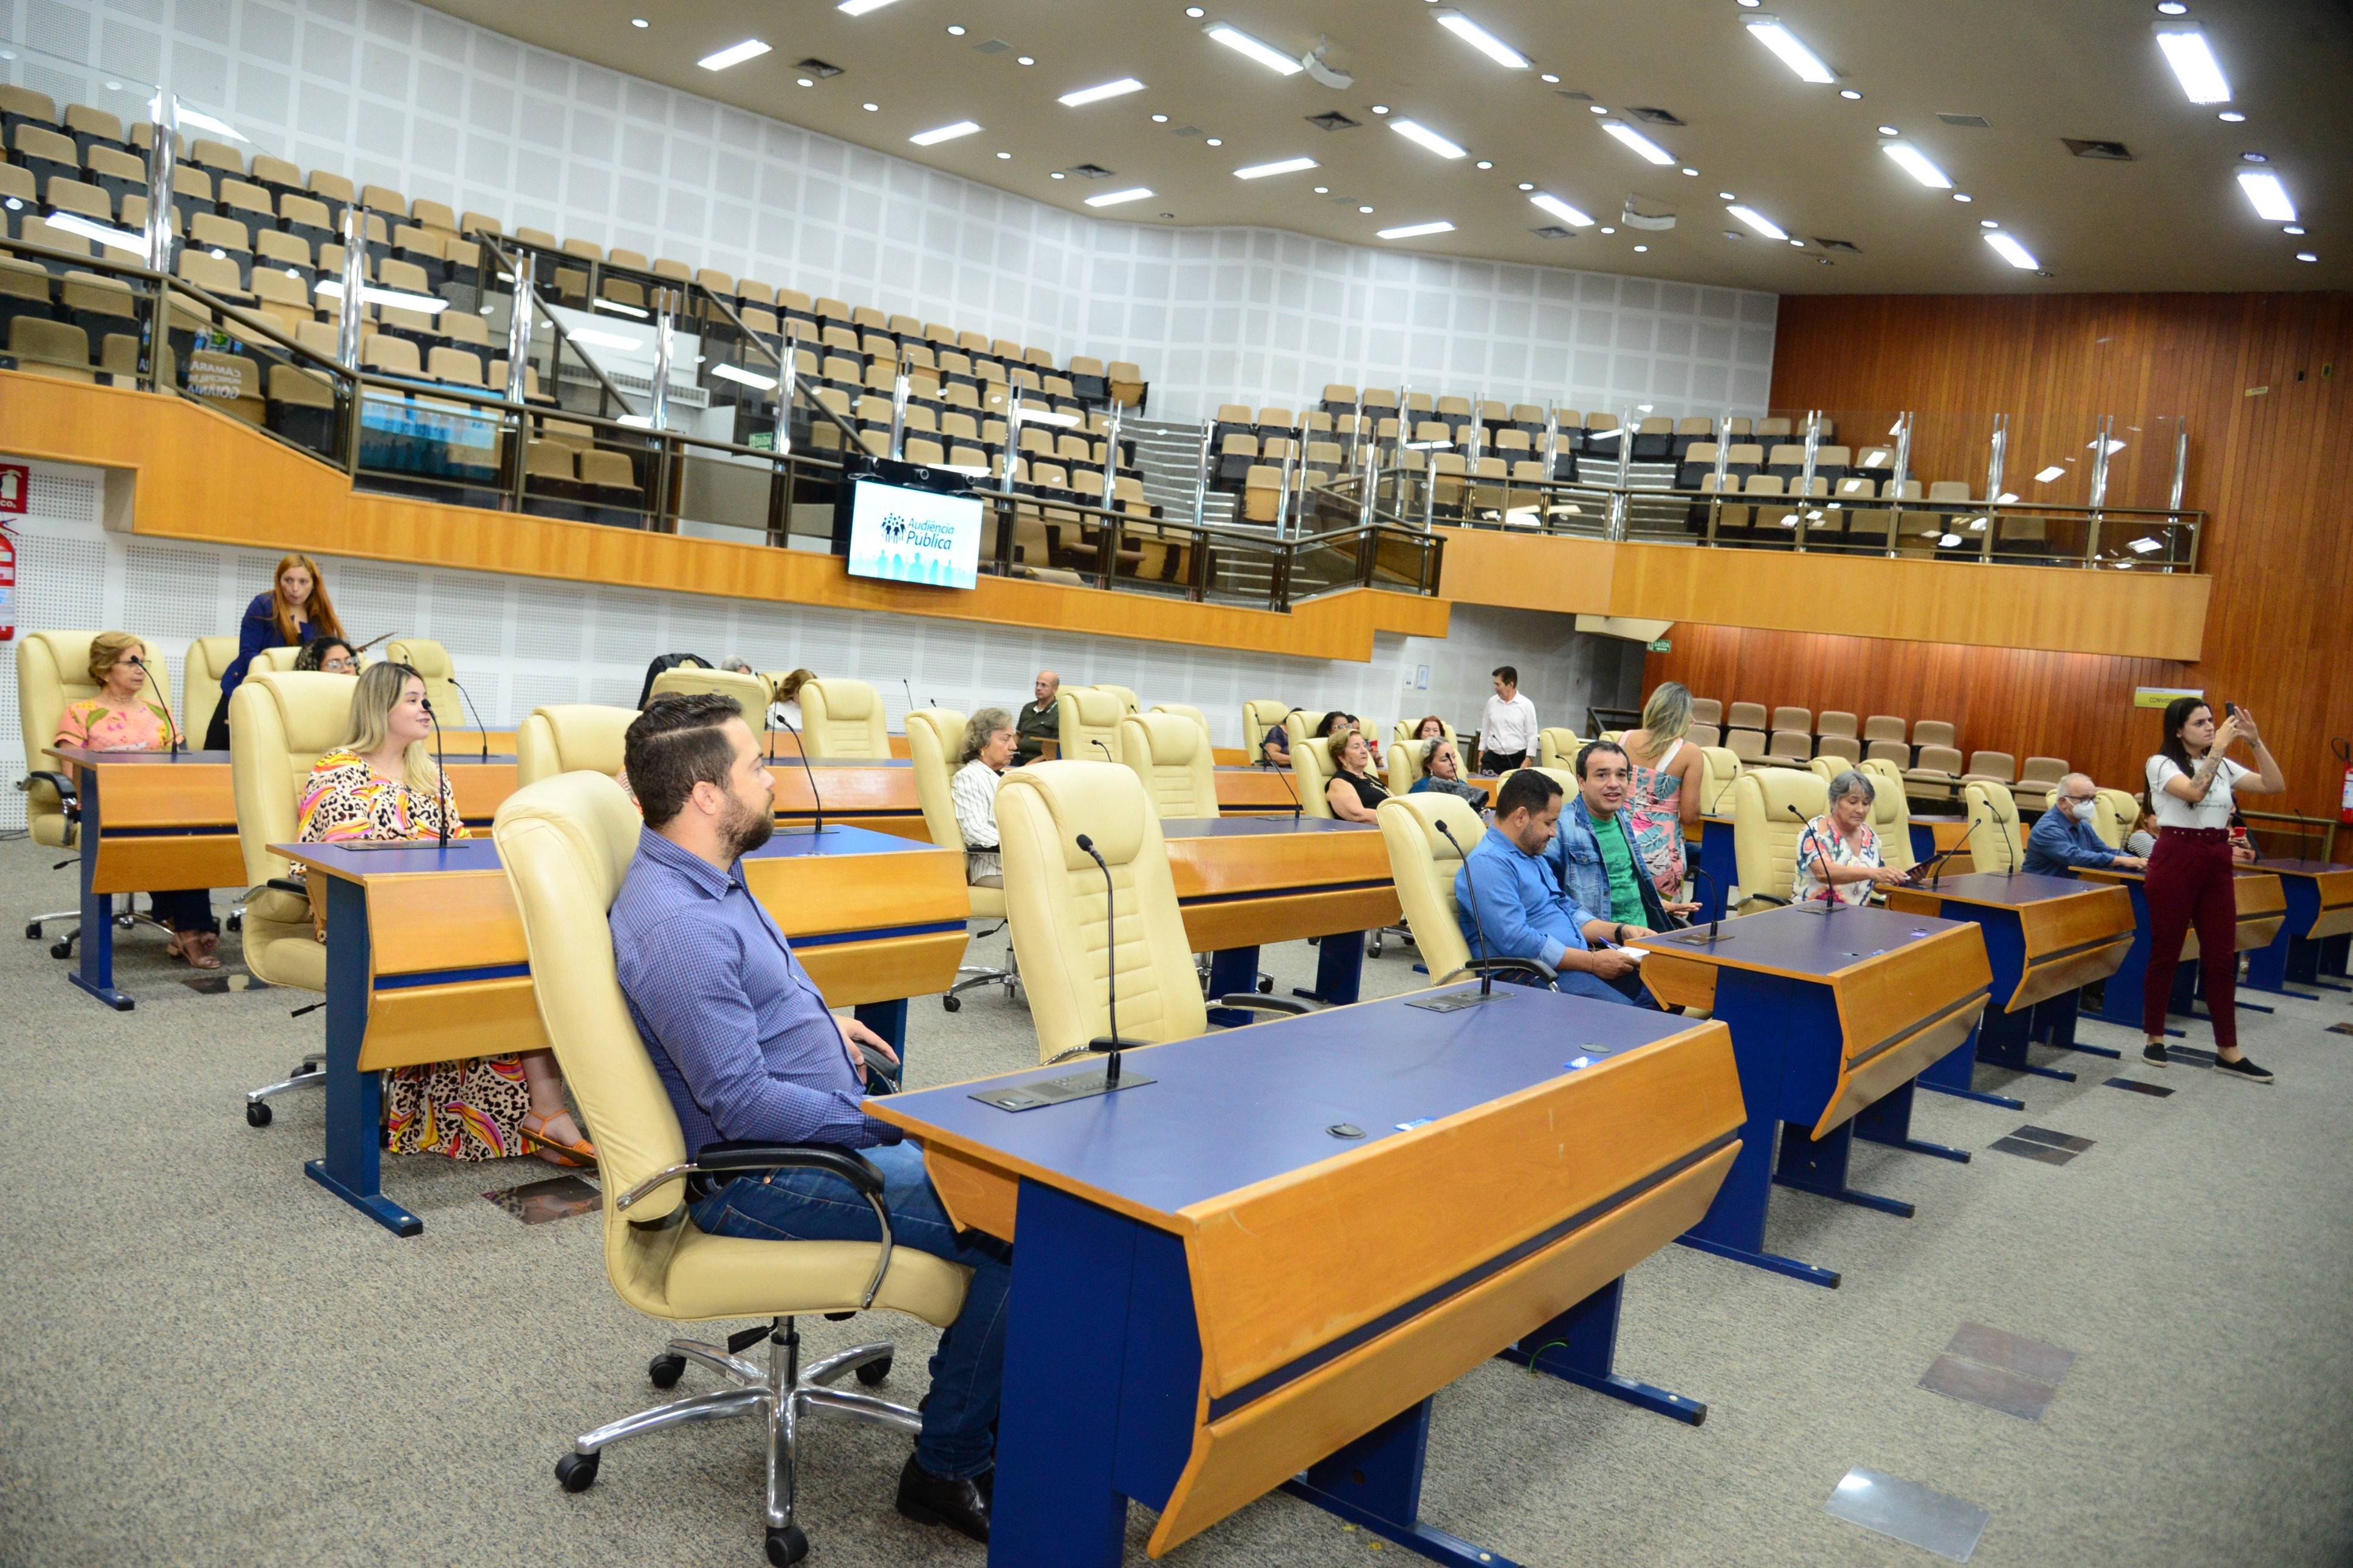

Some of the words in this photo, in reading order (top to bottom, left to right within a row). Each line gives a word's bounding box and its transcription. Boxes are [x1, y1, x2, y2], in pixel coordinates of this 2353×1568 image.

[755, 435, 771, 447] SAÍDA
[907, 518, 954, 534] Audiência
[906, 530, 952, 550] Pública
[1654, 640, 1670, 648] SAÍDA
